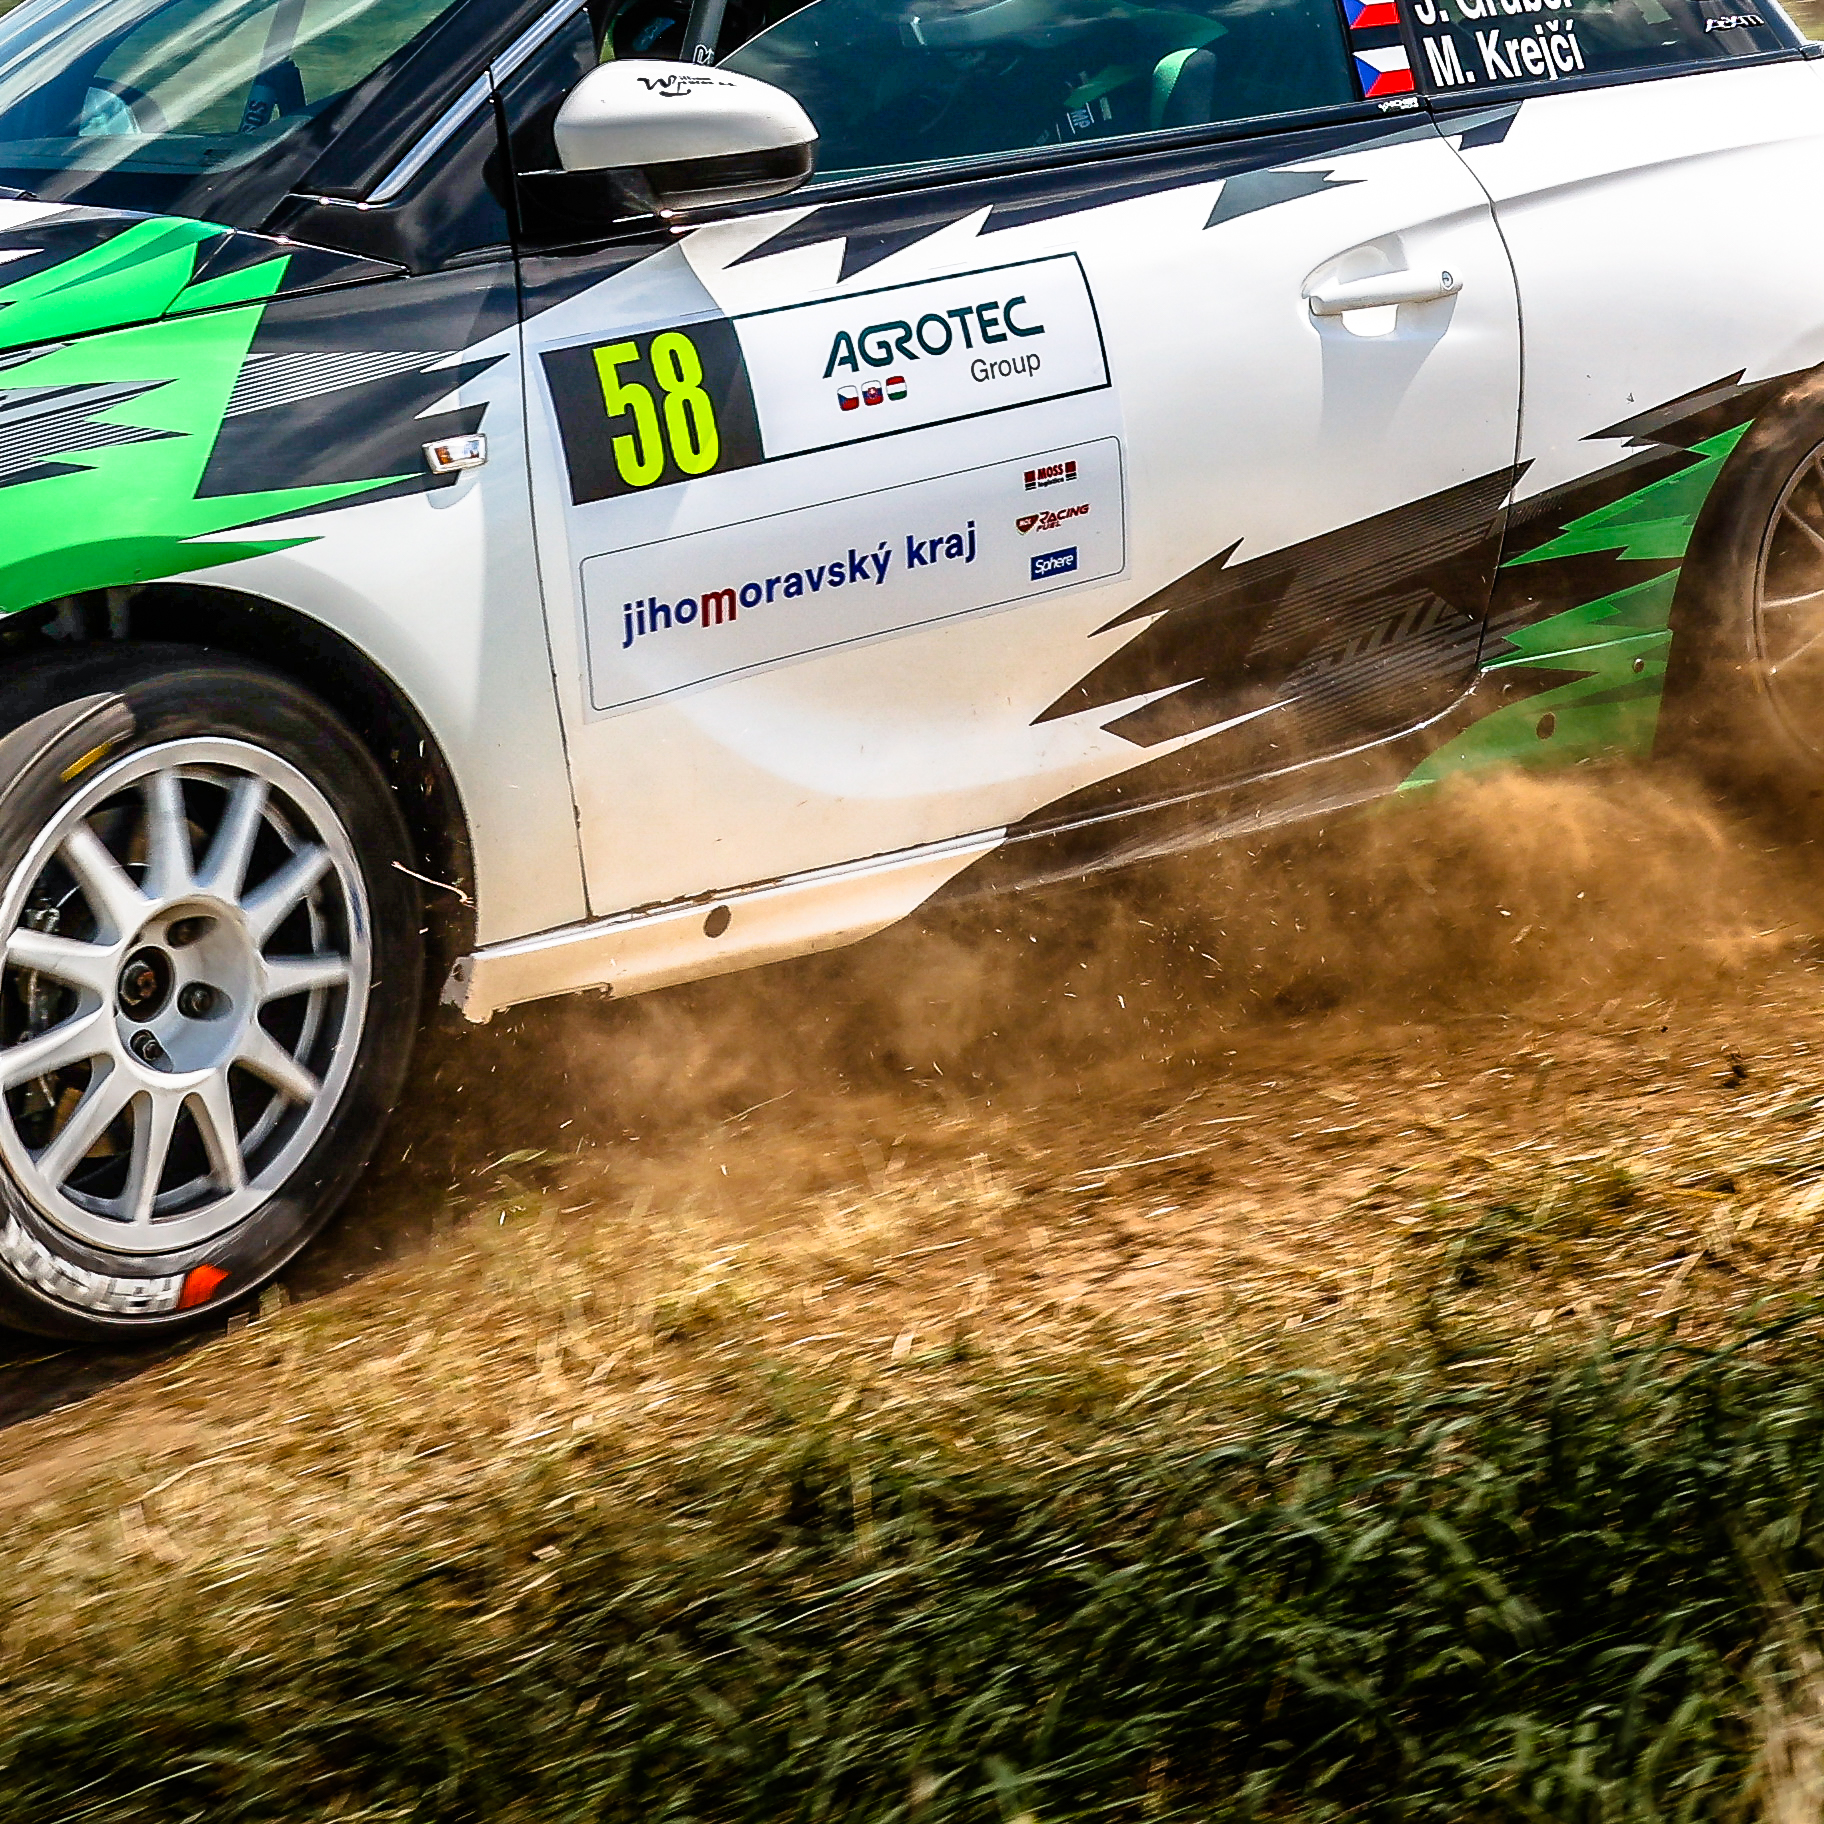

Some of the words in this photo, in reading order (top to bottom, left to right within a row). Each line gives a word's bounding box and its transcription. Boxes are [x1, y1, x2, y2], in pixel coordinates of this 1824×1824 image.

[1422, 31, 1475, 87] M.
[1477, 17, 1585, 82] Krejčí
[970, 352, 1042, 384] Group
[592, 331, 721, 487] 58
[823, 295, 1045, 379] AGROTEC
[1037, 463, 1064, 480] MOSS
[1039, 503, 1090, 525] RACING
[1034, 555, 1074, 575] Sphere
[622, 528, 893, 649] jihomoravský
[906, 520, 978, 572] kraj
